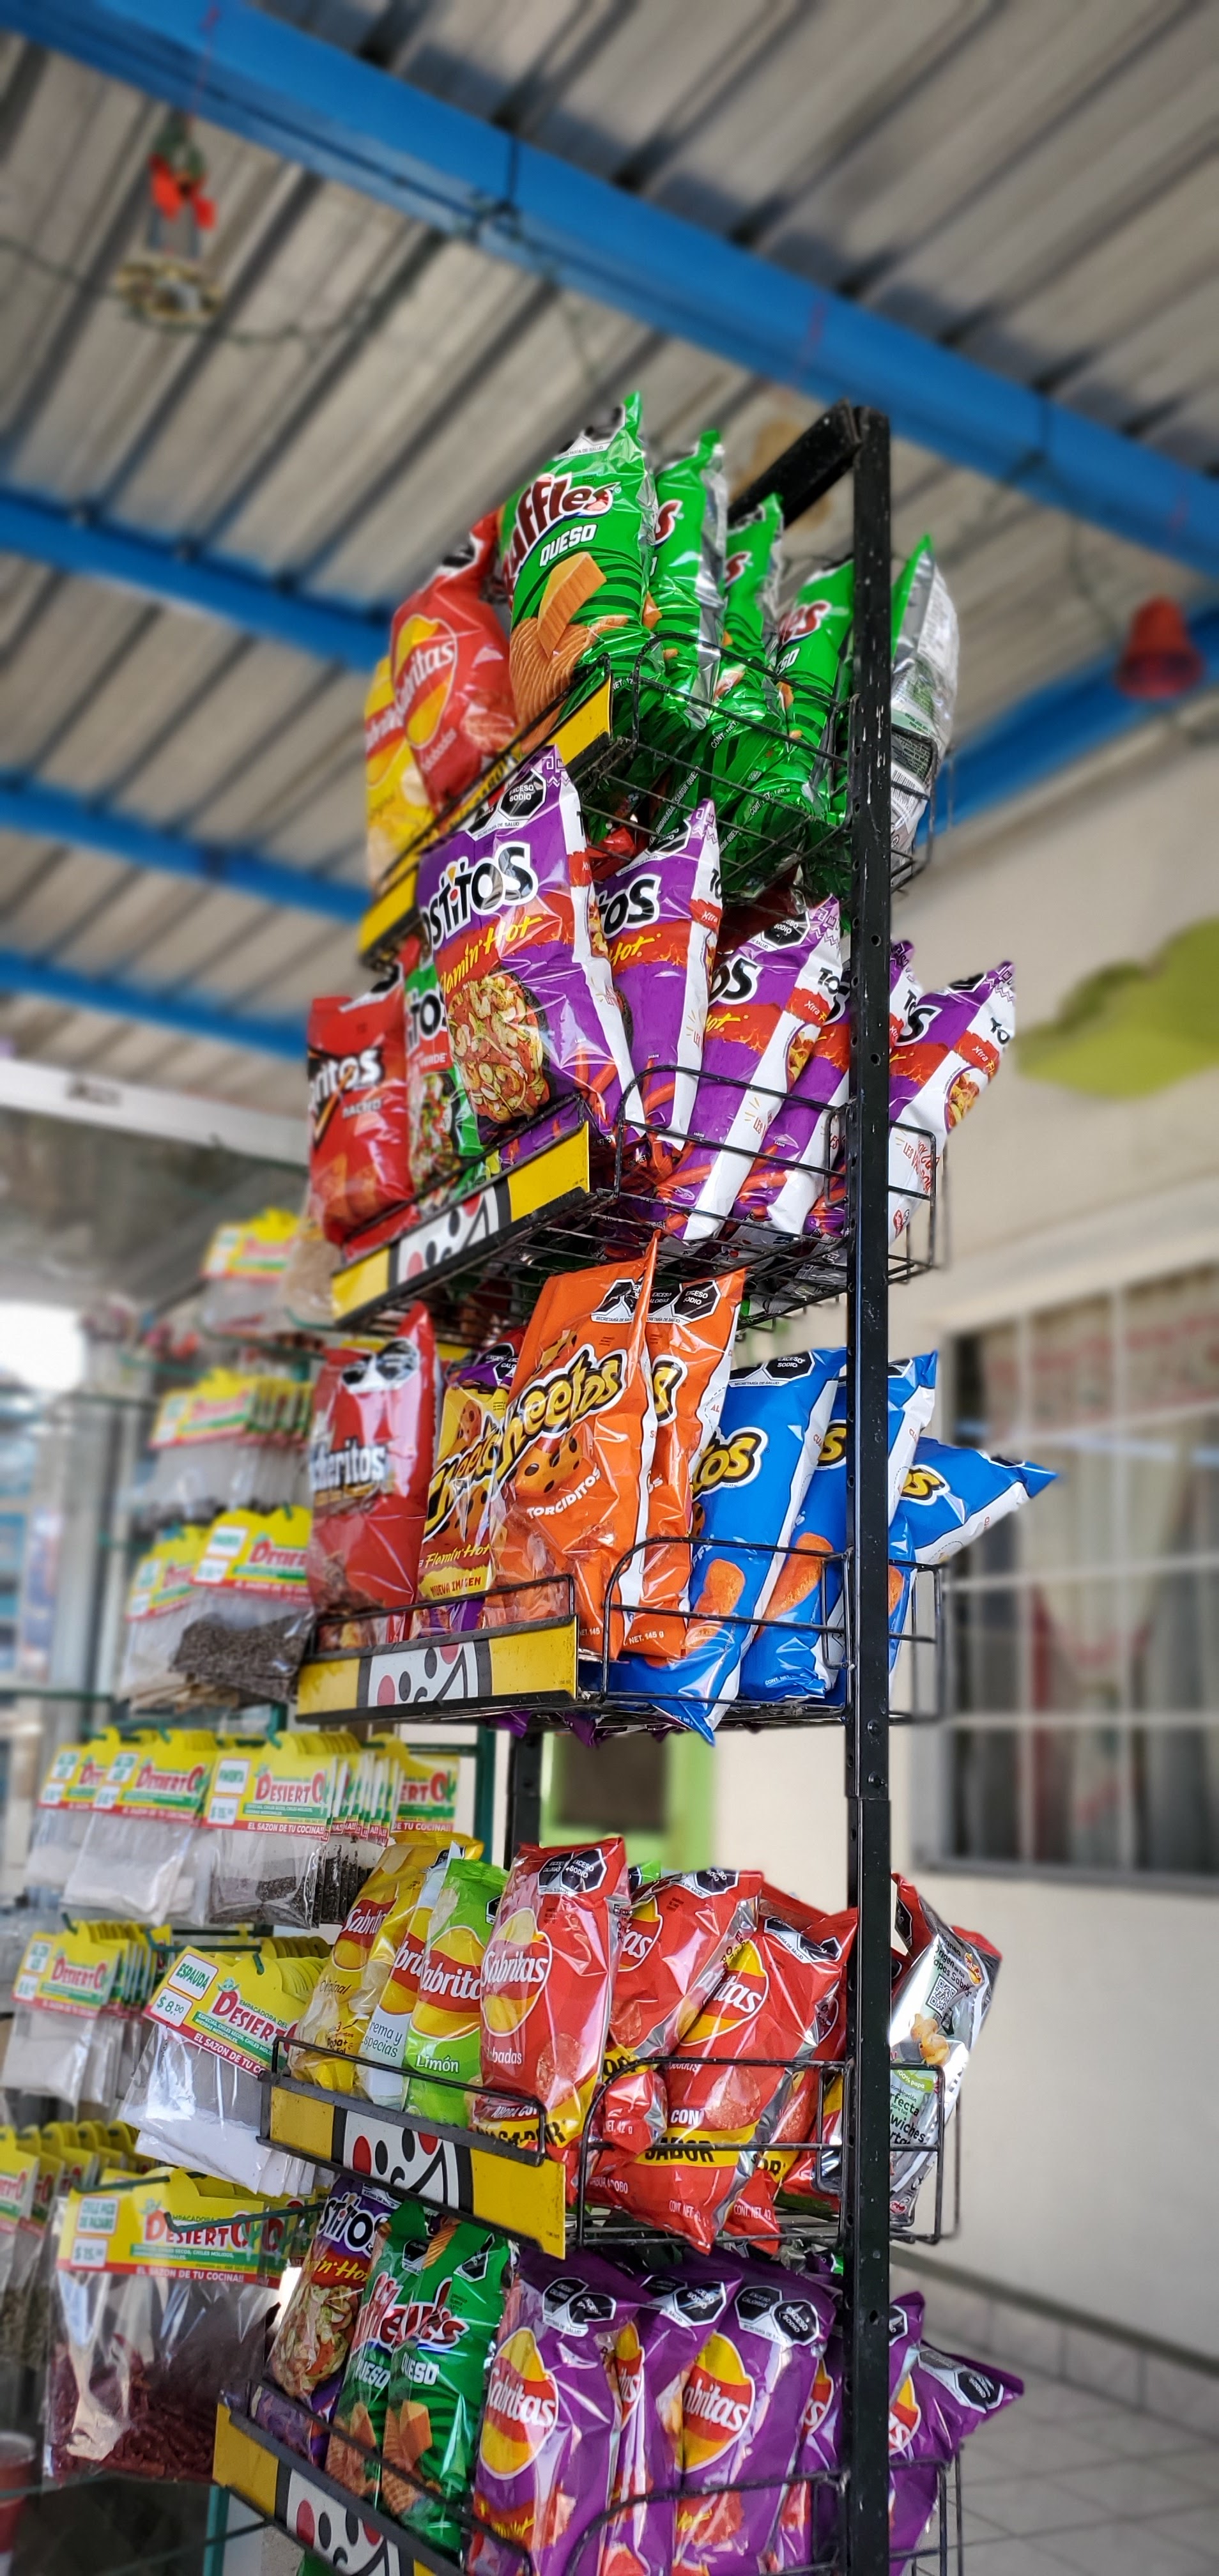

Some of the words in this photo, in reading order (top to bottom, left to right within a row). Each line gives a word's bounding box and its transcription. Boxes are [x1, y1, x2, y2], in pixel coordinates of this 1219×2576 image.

[539, 524, 598, 567] QUESO
[710, 732, 725, 749] CONT.
[509, 793, 532, 802] SODIO
[675, 783, 689, 804] SABOR
[702, 911, 718, 923] Xtra
[481, 915, 543, 955] Hot
[774, 924, 792, 935] SODIO
[755, 940, 769, 950] SALUD
[804, 1000, 820, 1016] Xtra
[972, 1046, 989, 1062] Xtra
[903, 1142, 914, 1159] LES
[526, 1466, 601, 1519] TORCIDITOS
[425, 1547, 464, 1568] Flamin'
[463, 1544, 491, 1558] Hot
[430, 1583, 450, 1597] NUEVA
[589, 1627, 601, 1636] 145
[629, 1634, 644, 1645] NET.
[645, 1632, 657, 1640] 145
[659, 1630, 664, 1639] g
[765, 1676, 779, 1685] CONT.
[257, 1823, 278, 1832] SAZON
[279, 1824, 288, 1832] DE
[288, 1825, 296, 1833] TU
[296, 1825, 325, 1835] COCINA!!
[569, 1864, 588, 1879] SODIO
[572, 1859, 594, 1872] EXCESO
[482, 1950, 549, 1988] Sabritas
[933, 1958, 951, 1977] apas
[176, 1963, 210, 1991] ESPAUDA
[157, 1995, 166, 2009] $
[238, 1999, 277, 2023] EMPACADORA
[277, 2019, 288, 2029] DEL
[369, 2021, 395, 2039] rema
[395, 2032, 404, 2045] y
[194, 2032, 203, 2043] EL
[204, 2039, 229, 2057] SAZON
[229, 2052, 241, 2063] DE
[241, 2057, 253, 2069] TU
[362, 2035, 398, 2058] specias
[416, 2054, 459, 2073] Limón
[910, 2078, 925, 2089] papa
[890, 2092, 920, 2117] rfecta
[671, 2109, 702, 2126] CON
[617, 2121, 625, 2133] 42
[628, 2126, 633, 2135] g
[890, 2113, 926, 2143] wiches
[734, 2204, 750, 2216] CONT.
[762, 2208, 772, 2221] 42
[179, 2269, 190, 2279] DE
[192, 2269, 204, 2280] TU
[206, 2271, 245, 2283] COCINA!!
[782, 2314, 801, 2333] SODIO
[401, 2352, 440, 2386] QUESO
